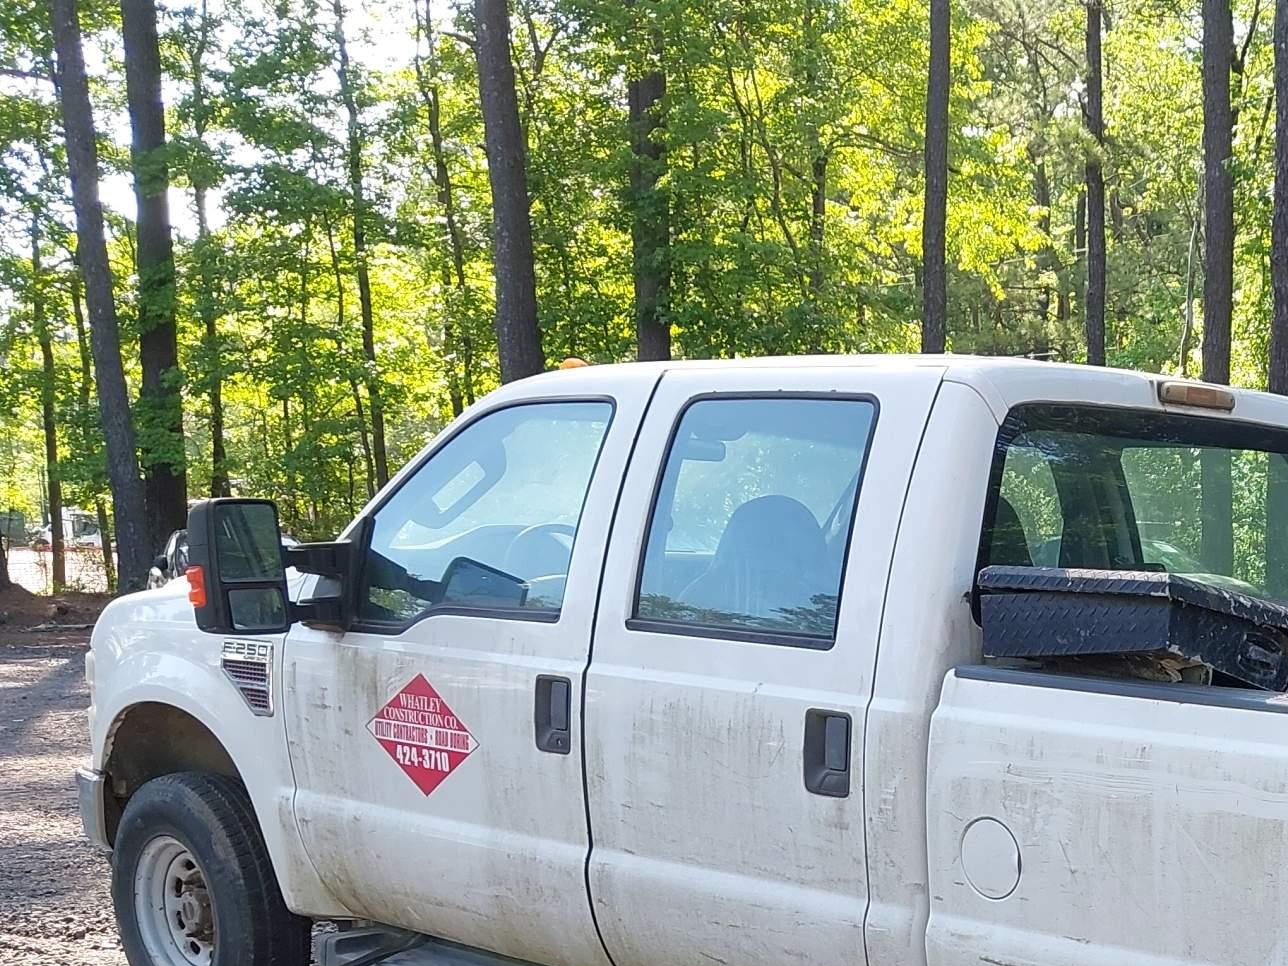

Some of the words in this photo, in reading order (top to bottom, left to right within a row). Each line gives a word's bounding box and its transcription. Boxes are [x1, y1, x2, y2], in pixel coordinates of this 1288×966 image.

[223, 641, 268, 657] F-250
[400, 693, 441, 713] WHATLEY
[383, 706, 443, 727] CONSTRUCTION
[444, 715, 459, 730] CO.
[374, 720, 392, 739] UTILITY
[396, 744, 450, 772] 424-3710
